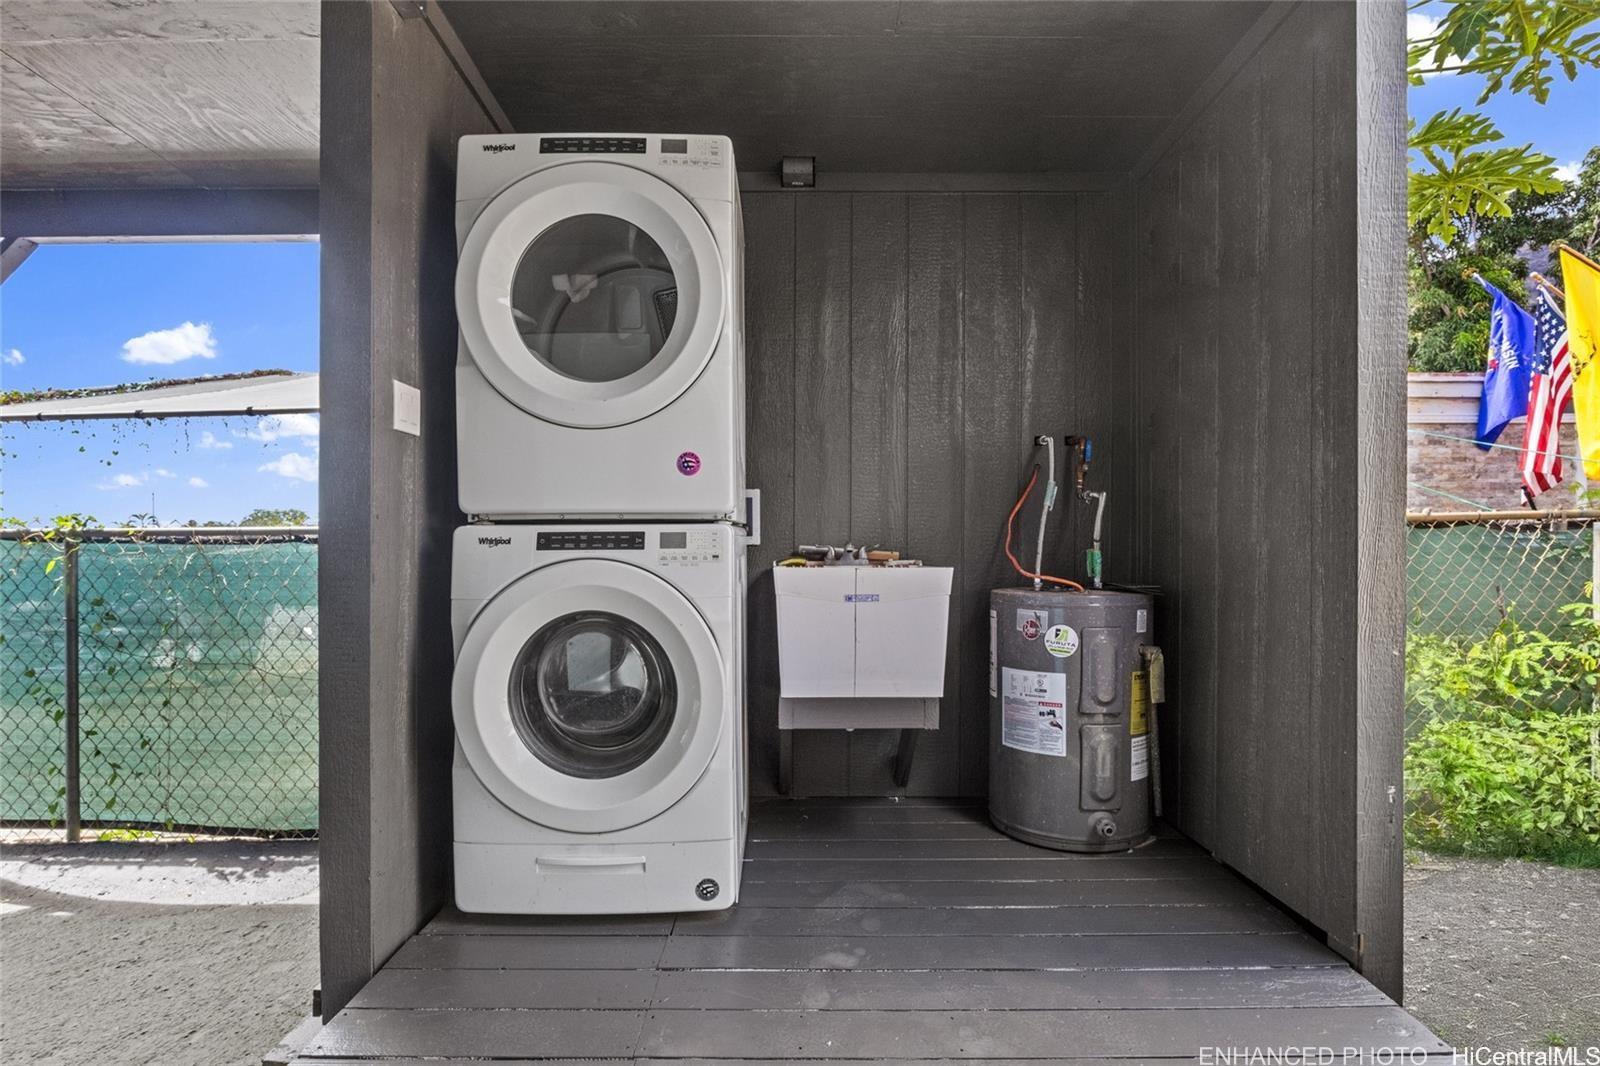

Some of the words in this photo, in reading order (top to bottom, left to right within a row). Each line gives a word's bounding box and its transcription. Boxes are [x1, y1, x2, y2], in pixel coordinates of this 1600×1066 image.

[483, 143, 515, 154] Whirlpool
[478, 537, 511, 548] Whirlpool
[1046, 640, 1076, 648] FURUTA
